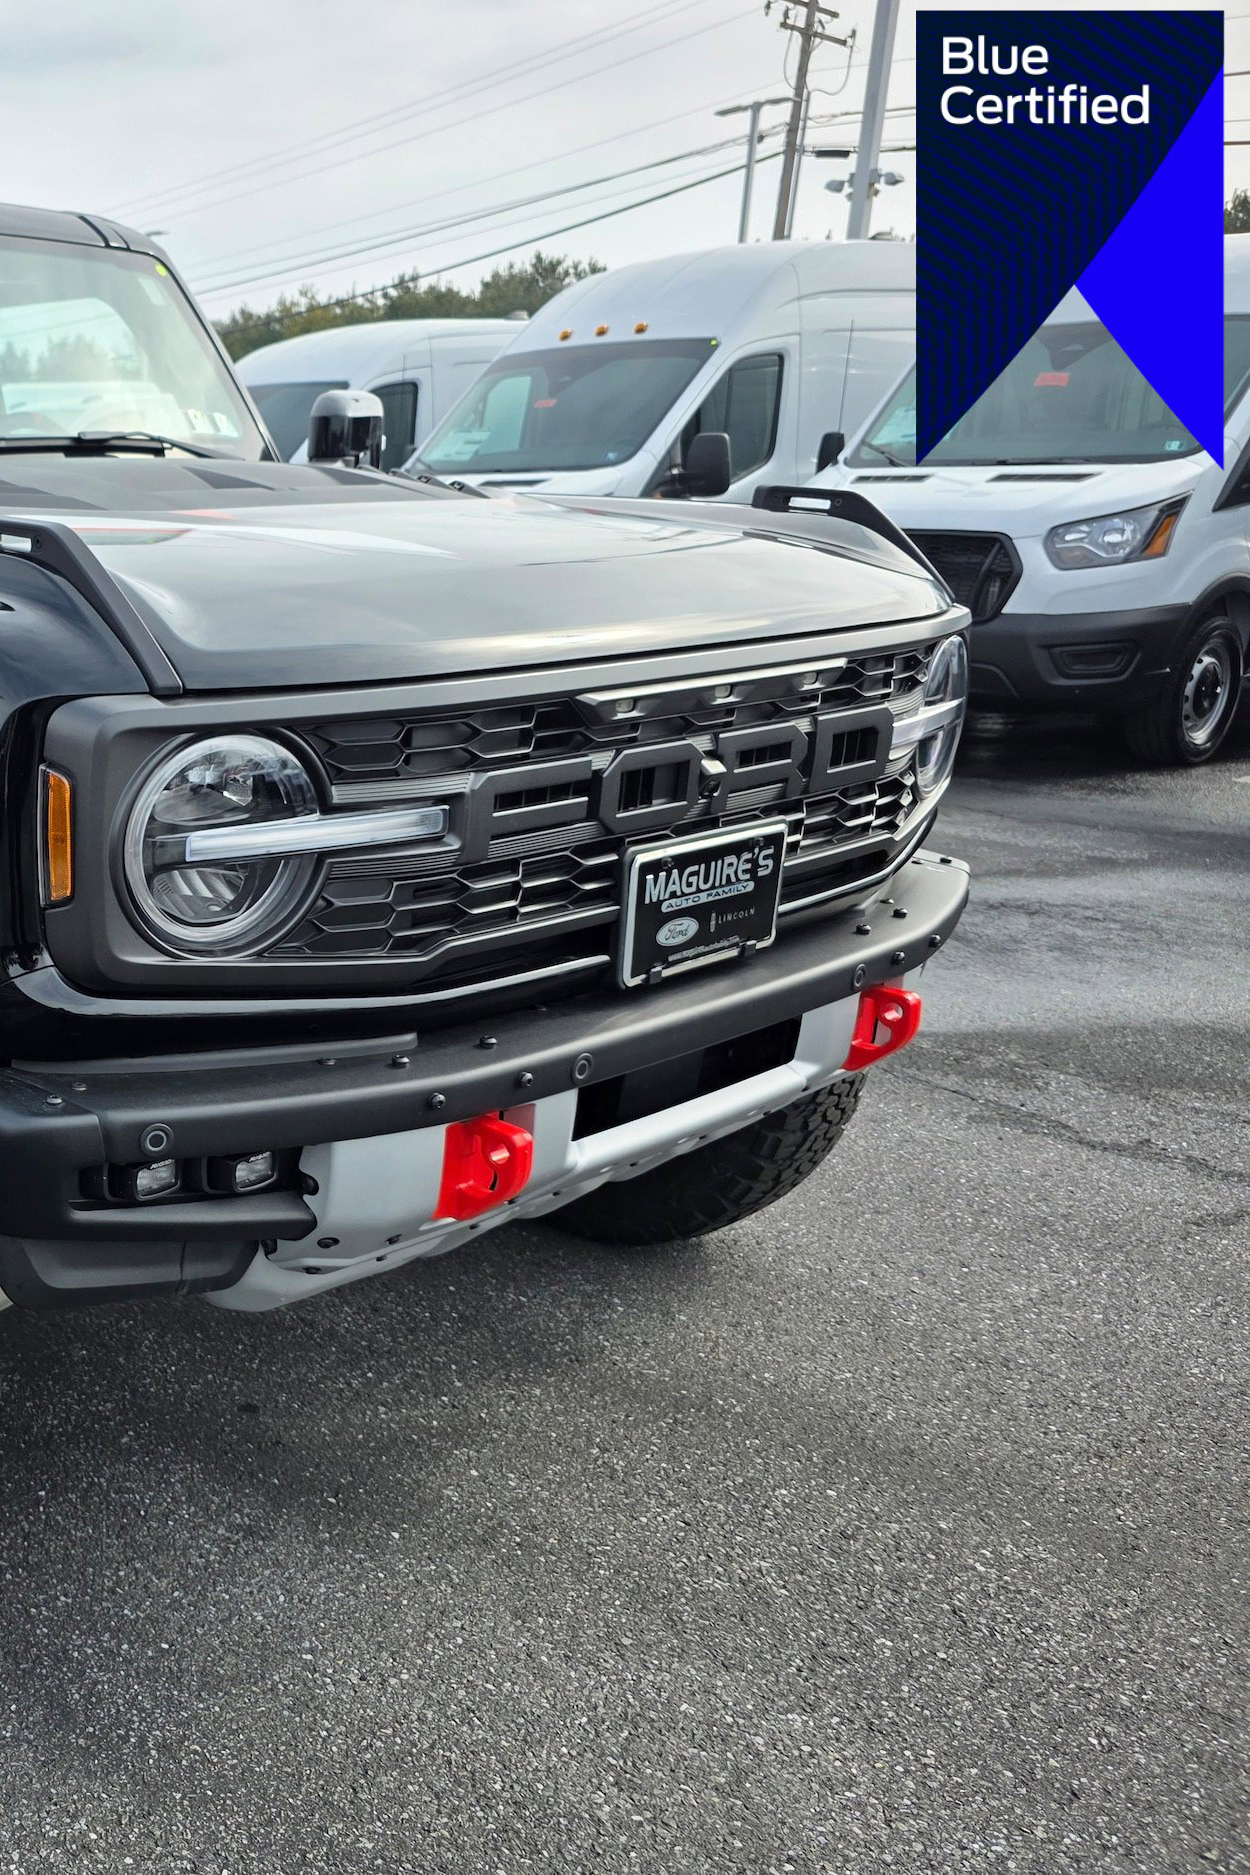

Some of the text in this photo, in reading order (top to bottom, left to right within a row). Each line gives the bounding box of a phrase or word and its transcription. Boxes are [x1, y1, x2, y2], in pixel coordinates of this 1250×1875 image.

[459, 702, 894, 866] FORD
[644, 847, 774, 904] MAGUIRE'S
[665, 883, 749, 910] AUTO FAMILY
[717, 907, 756, 924] LINCOLN
[664, 922, 690, 941] Ford
